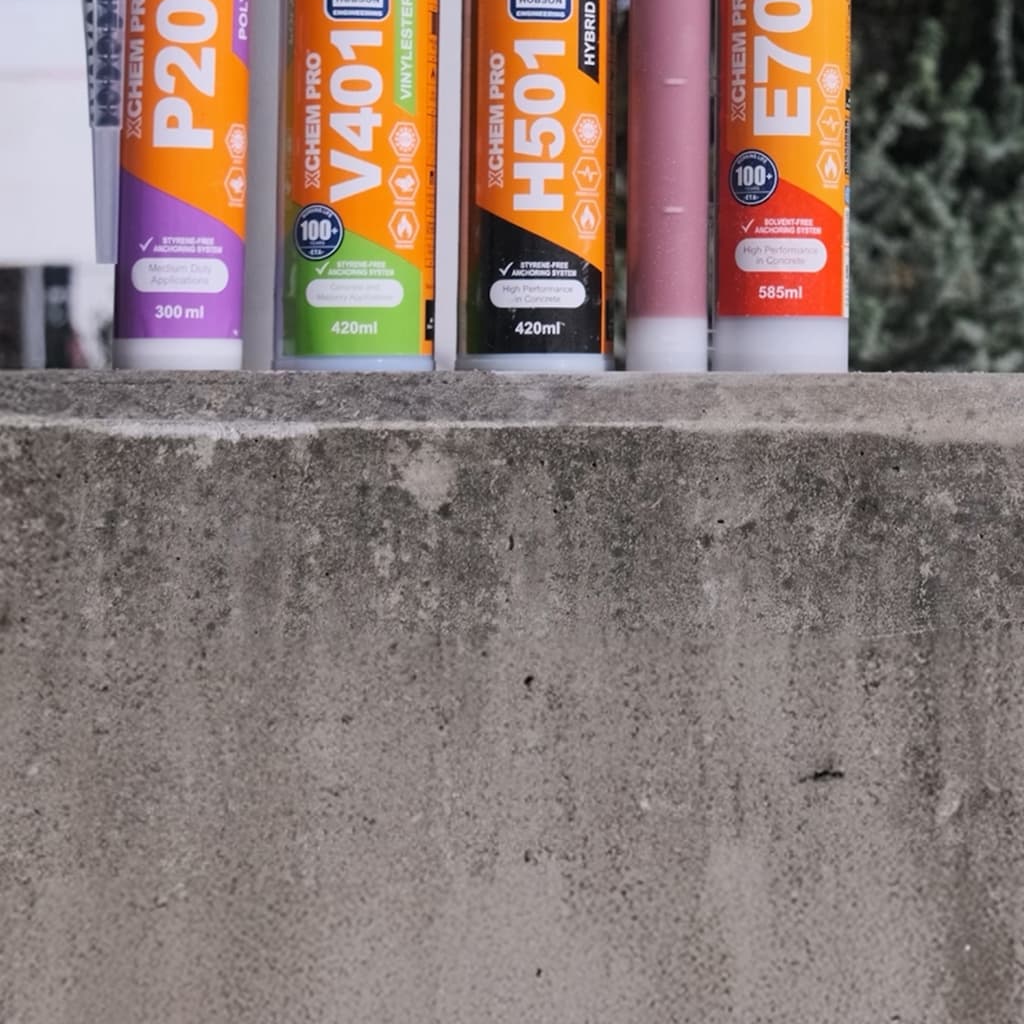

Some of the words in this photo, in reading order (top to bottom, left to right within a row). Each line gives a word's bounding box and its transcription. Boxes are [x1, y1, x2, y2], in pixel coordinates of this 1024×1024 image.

[583, 0, 597, 67] HYBRID
[126, 38, 145, 140] XCHEM
[305, 51, 322, 100] PRO
[489, 51, 506, 100] PRO
[731, 34, 747, 123] XCHEM
[304, 104, 322, 190] XCHEM
[329, 29, 384, 204] V401
[488, 104, 505, 189] XCHEM
[513, 38, 566, 212] H501
[155, 304, 183, 319] 300
[184, 304, 204, 319] ml
[758, 286, 803, 299] 585ml
[331, 321, 378, 335] 420ml
[514, 321, 561, 335] 420ml
